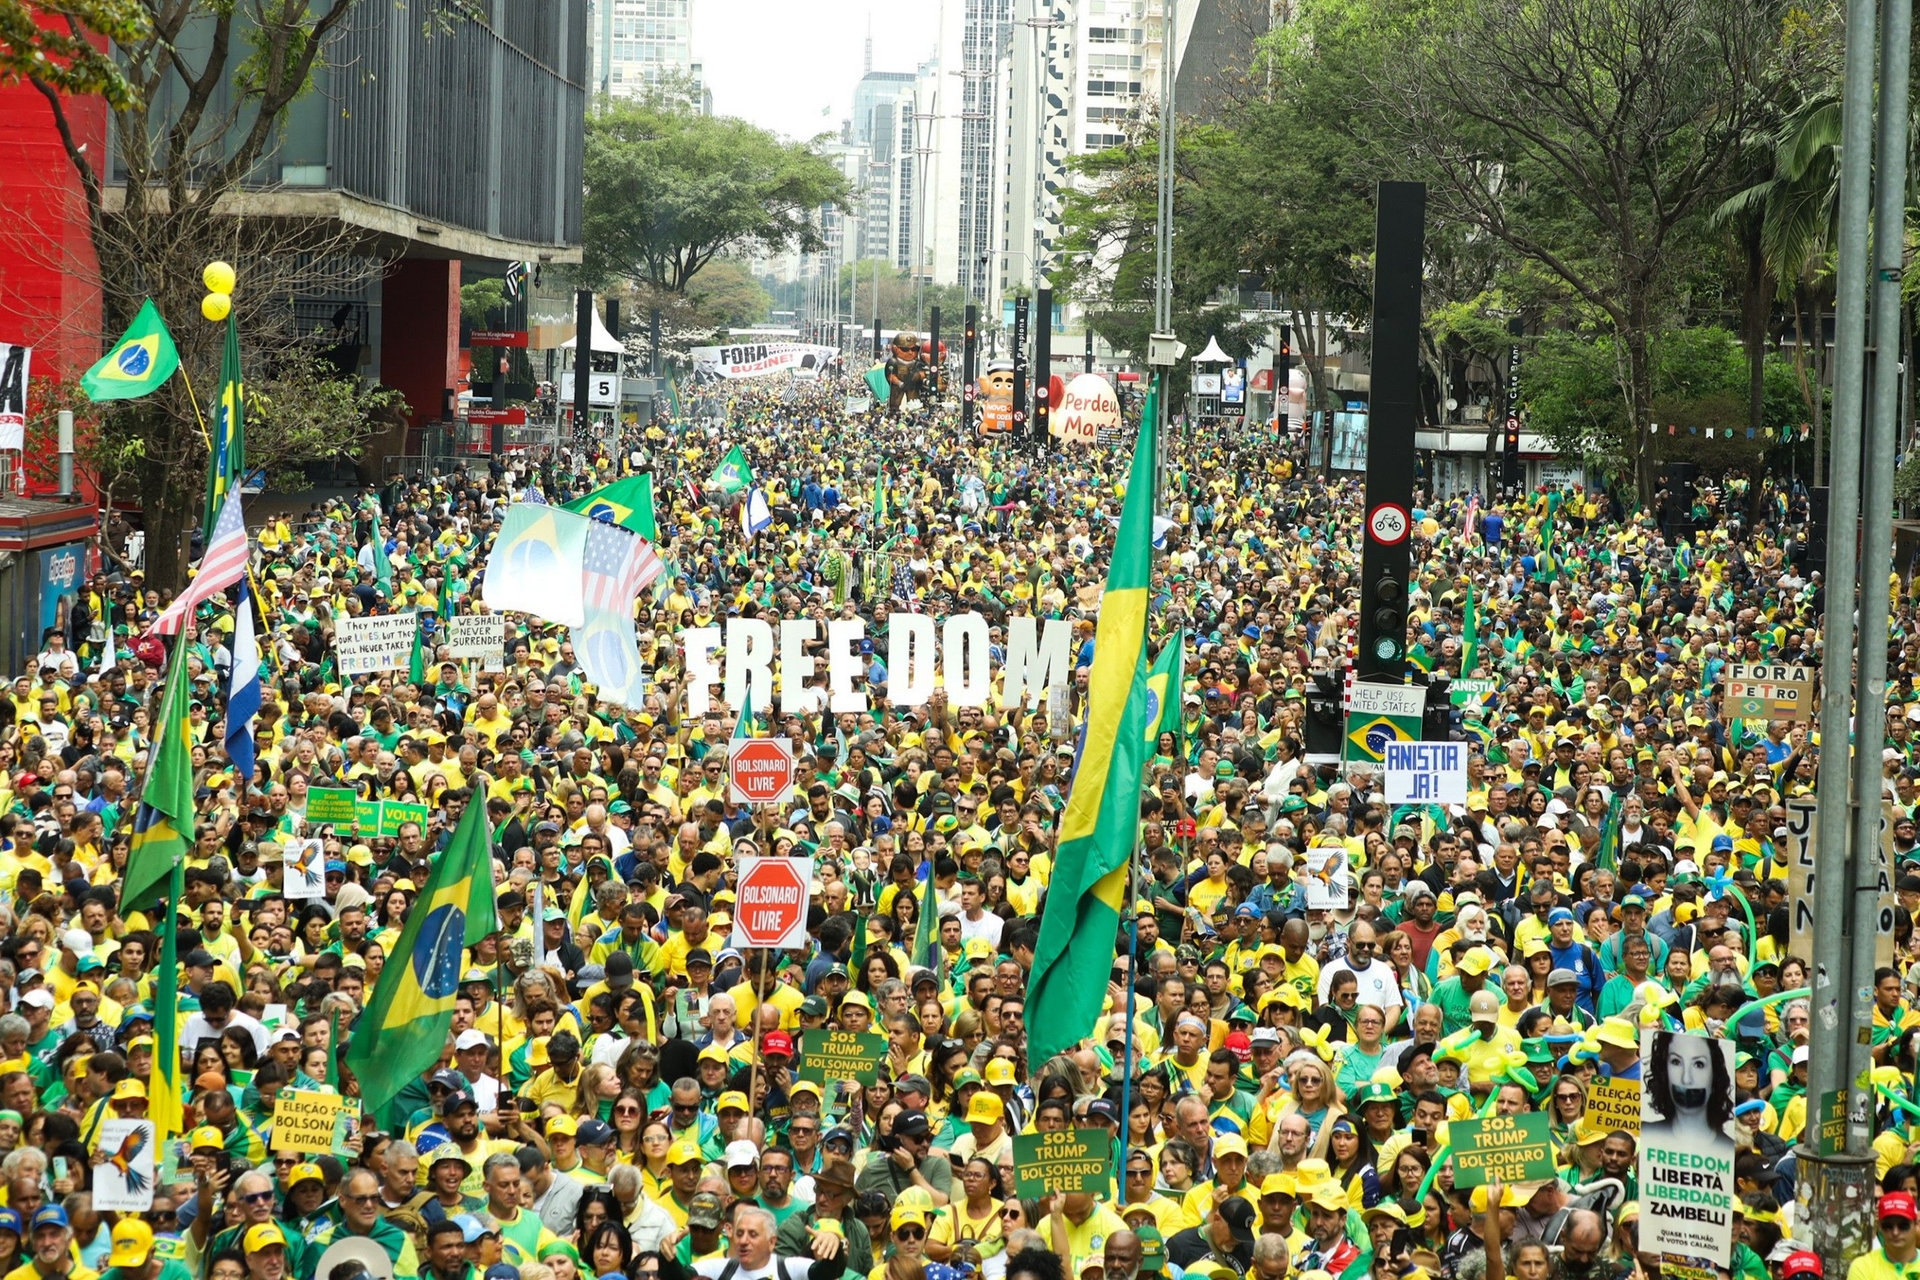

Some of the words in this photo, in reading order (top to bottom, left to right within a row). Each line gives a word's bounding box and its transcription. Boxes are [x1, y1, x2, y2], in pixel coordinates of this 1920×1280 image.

[720, 345, 768, 365] FORA
[1510, 345, 1519, 372] Branc
[731, 354, 794, 373] BUZINE!
[599, 382, 610, 396] 5
[1510, 376, 1518, 399] Casa
[1065, 392, 1119, 416] Perdeu,
[373, 619, 389, 629] MAY
[395, 617, 415, 626] TAKE
[458, 618, 472, 626] WE
[474, 616, 503, 626] SHALL
[460, 627, 491, 635] NEVER
[338, 635, 352, 645] OUR
[453, 635, 503, 647] SURRENDER
[340, 646, 358, 655] WILL
[359, 643, 385, 653] NEVER
[387, 641, 405, 650] TAKE
[1733, 665, 1806, 681] FORA
[1453, 680, 1496, 692] ANISTIA
[1355, 689, 1383, 700] HELP
[1463, 691, 1483, 706] JÁ
[1380, 701, 1416, 713] STATES
[1388, 745, 1458, 771] ANISTIA
[736, 759, 785, 773] BOLSONARO
[748, 777, 775, 791] LIVRE
[1406, 771, 1439, 798] JÁ!
[357, 806, 373, 815] TIÇA
[386, 808, 423, 823] VOLTA
[743, 886, 798, 904] BOLSONARO
[752, 911, 783, 931] LIVRE
[830, 1032, 856, 1043] SOS
[822, 1042, 864, 1055] TRUMP
[806, 1058, 873, 1071] BOLSONARO
[1596, 1087, 1640, 1102] ELEIÇÃO
[283, 1102, 328, 1116] ELEIÇÃO
[1588, 1099, 1641, 1117] BOLSON
[276, 1115, 335, 1131] BOLSONA
[1481, 1116, 1515, 1132] SOS
[1596, 1113, 1602, 1125] É
[285, 1130, 291, 1143] É
[294, 1134, 332, 1147] DITADU
[1043, 1131, 1076, 1145] SOS
[1473, 1129, 1528, 1148] TRUMP
[1834, 1138, 1845, 1151] FR
[1035, 1144, 1087, 1160] TRUMP
[1459, 1149, 1545, 1169] BOLSONARO
[1647, 1148, 1730, 1174] FREEDOM
[1021, 1163, 1102, 1181] BOLSONARO
[1484, 1164, 1525, 1183] FREE
[1653, 1167, 1723, 1191] LIBERTÀ
[1043, 1176, 1082, 1193] FREE
[1645, 1183, 1731, 1209] LIBERDADE
[1650, 1201, 1725, 1227] ZAMBELLI
[1661, 1229, 1682, 1238] QUASE
[1689, 1233, 1714, 1243] MILHÃO
[1666, 1237, 1688, 1246] VOTOS
[1690, 1240, 1719, 1252] CALADOS
